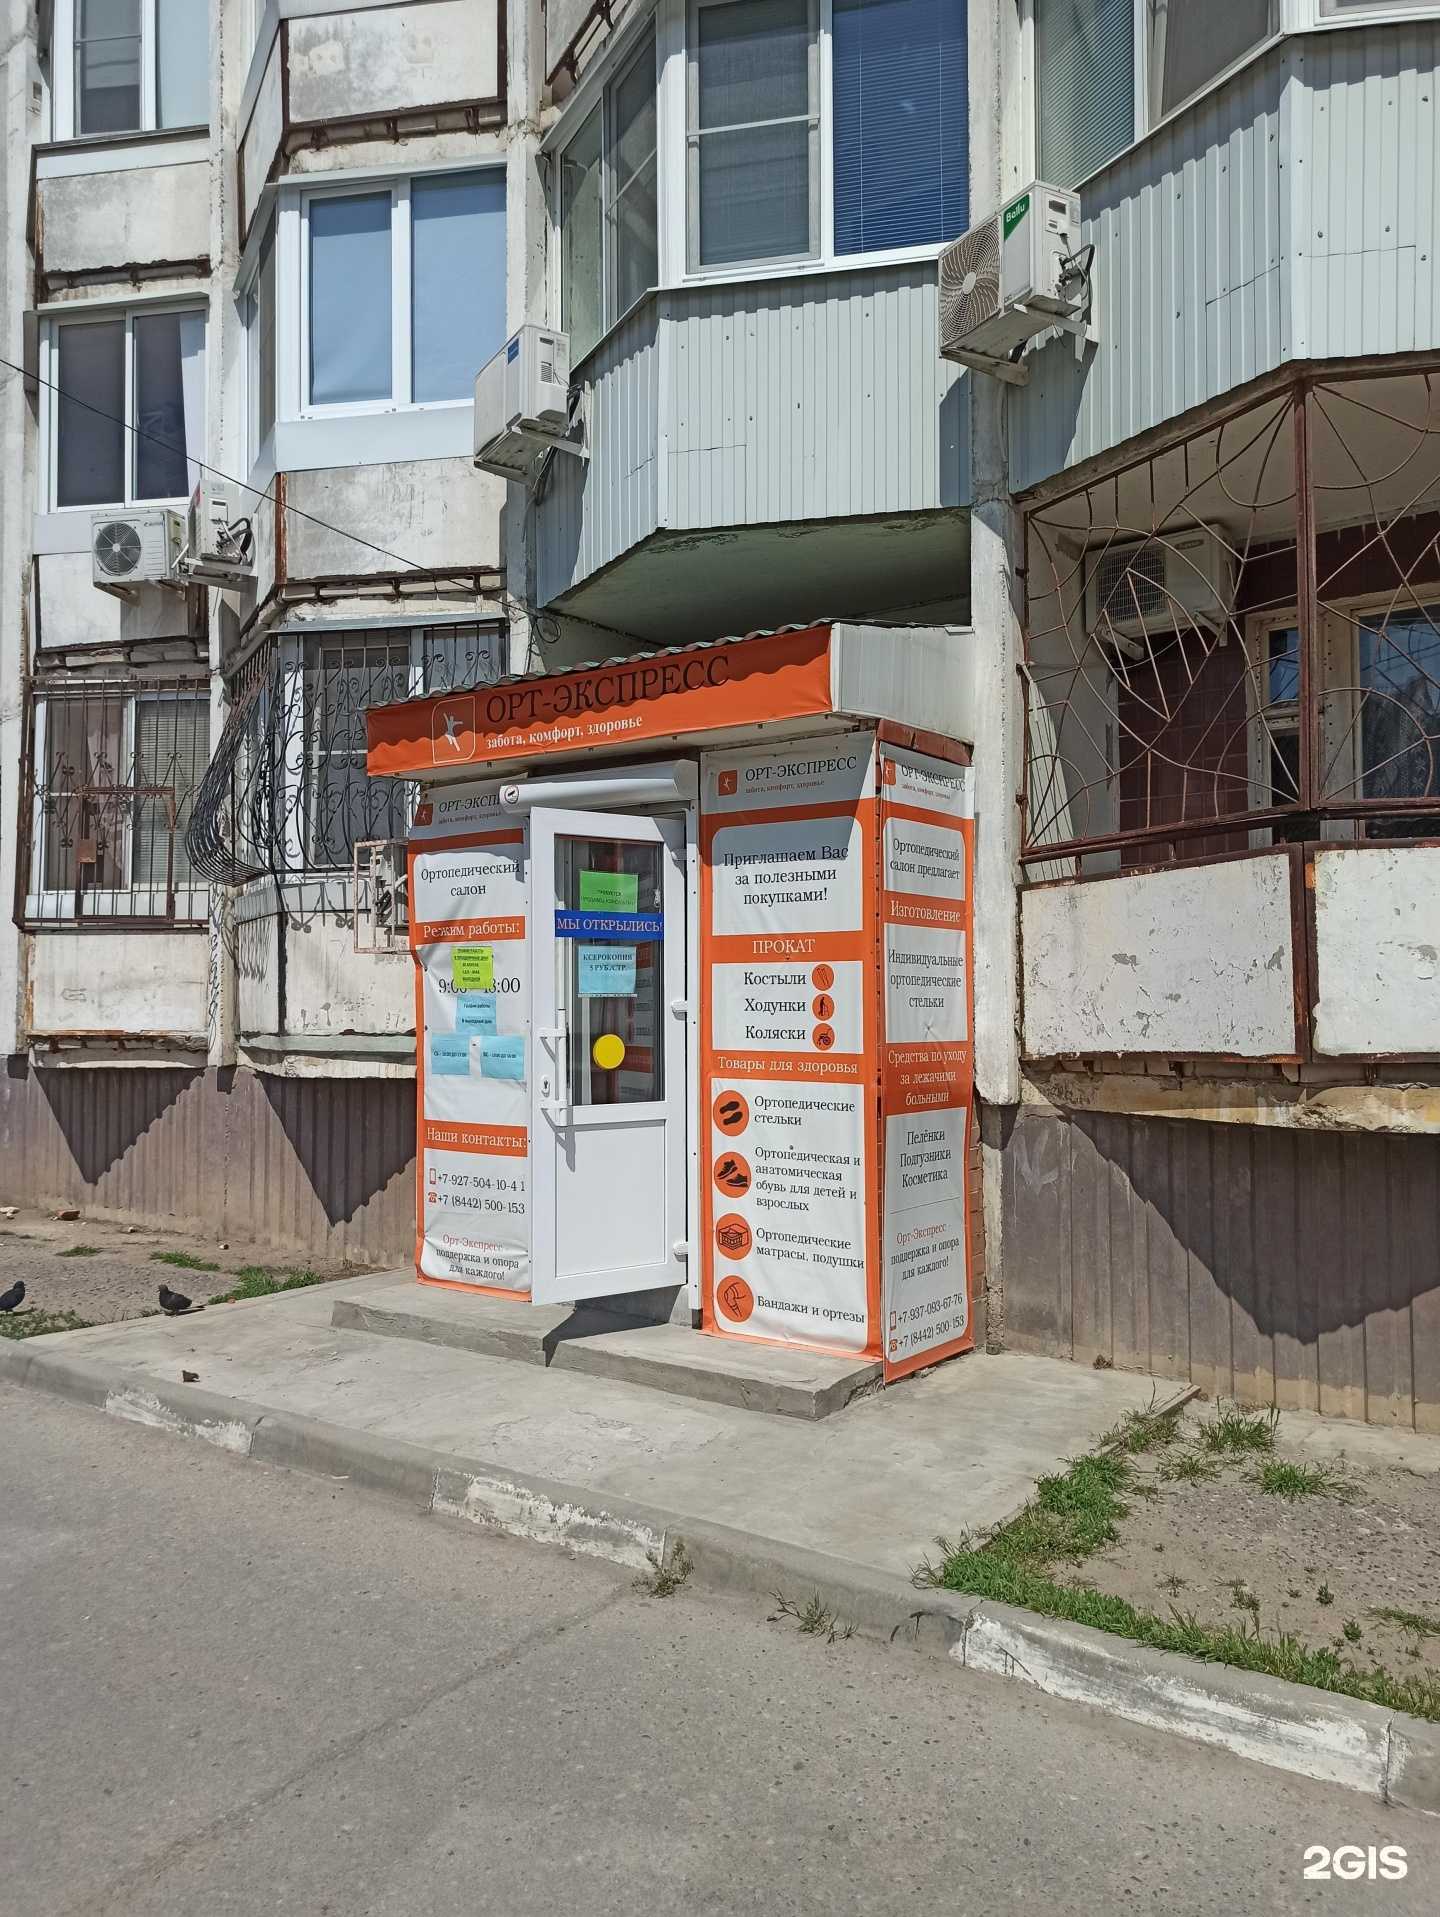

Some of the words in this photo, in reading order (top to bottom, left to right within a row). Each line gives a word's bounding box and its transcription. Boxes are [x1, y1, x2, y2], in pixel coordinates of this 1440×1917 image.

[1006, 203, 1025, 223] Ballu
[486, 656, 729, 723] ОРТ-ЭКСПРЕСС
[487, 733, 526, 750] забота,
[529, 724, 584, 745] комфорт,
[587, 715, 643, 735] здоровье
[745, 756, 857, 782] ОРТ-ЭКСПРЕСС
[901, 764, 966, 792] ОРТ-ЭКСПРЕСС
[723, 849, 816, 869] Приглашаем
[821, 846, 849, 859] Вас
[892, 838, 960, 861] Ортопедический
[421, 859, 520, 883] Ортопедический
[735, 875, 749, 885] за
[754, 869, 837, 885] полезными
[890, 860, 915, 874] салон
[917, 863, 960, 880] предлагает
[450, 885, 486, 896] салон
[743, 887, 828, 907] покупками!
[890, 900, 961, 922] Изготовление
[424, 924, 465, 938] Режим
[468, 921, 520, 938] работы:
[557, 918, 580, 930] МЫ
[583, 919, 663, 932] ОТКРЫЛИСЬ!
[752, 938, 816, 954] ПРОКАТ
[888, 949, 964, 968] Индивидуальные
[744, 971, 807, 985] Костыли
[890, 974, 962, 989] ортопедические
[744, 998, 806, 1015] Ходунки
[908, 996, 945, 1008] стельки
[745, 1025, 806, 1040] Коляски
[718, 1056, 765, 1073] Товары
[769, 1059, 793, 1072] для
[797, 1061, 858, 1075] здоровья
[888, 1050, 929, 1067] Средства
[932, 1053, 942, 1063] по
[943, 1050, 968, 1065] уходу
[899, 1074, 910, 1085] за
[912, 1071, 957, 1084] лежачими
[754, 1095, 856, 1112] Ортопедические
[905, 1091, 950, 1106] больными
[754, 1114, 802, 1126] стельки
[427, 1127, 458, 1143] Наши
[461, 1132, 527, 1148] контакты:
[906, 1129, 946, 1146] Пелёнки
[755, 1146, 850, 1166] Ортопедическая
[853, 1157, 861, 1166] и
[900, 1148, 952, 1168] Подгузники
[755, 1165, 843, 1182] анатомическая
[902, 1169, 948, 1188] Косметика
[756, 1179, 786, 1193] обувь
[790, 1184, 810, 1195] для
[813, 1186, 846, 1199] детей
[849, 1190, 857, 1200] и
[438, 1194, 449, 1206] +7
[451, 1195, 482, 1210] (8442)
[484, 1199, 525, 1214] 500-153
[756, 1197, 809, 1211] взрослых
[756, 1227, 852, 1250] Ортопедические
[436, 1248, 481, 1263] поддержка
[483, 1256, 490, 1264] и
[492, 1257, 519, 1269] опора
[891, 1245, 930, 1265] поддержка
[932, 1243, 937, 1253] и
[938, 1237, 960, 1251] опора
[813, 1253, 865, 1269] подушки
[902, 1267, 915, 1281] для
[917, 1255, 949, 1276] каждого!
[465, 1266, 505, 1280] каждого!
[757, 1295, 808, 1314] Бандажи
[812, 1306, 819, 1315] и
[822, 1308, 865, 1323] ортезы
[897, 1292, 963, 1324] +7-937-093-67-76
[898, 1335, 909, 1348] +7
[910, 1326, 934, 1347] (8442)
